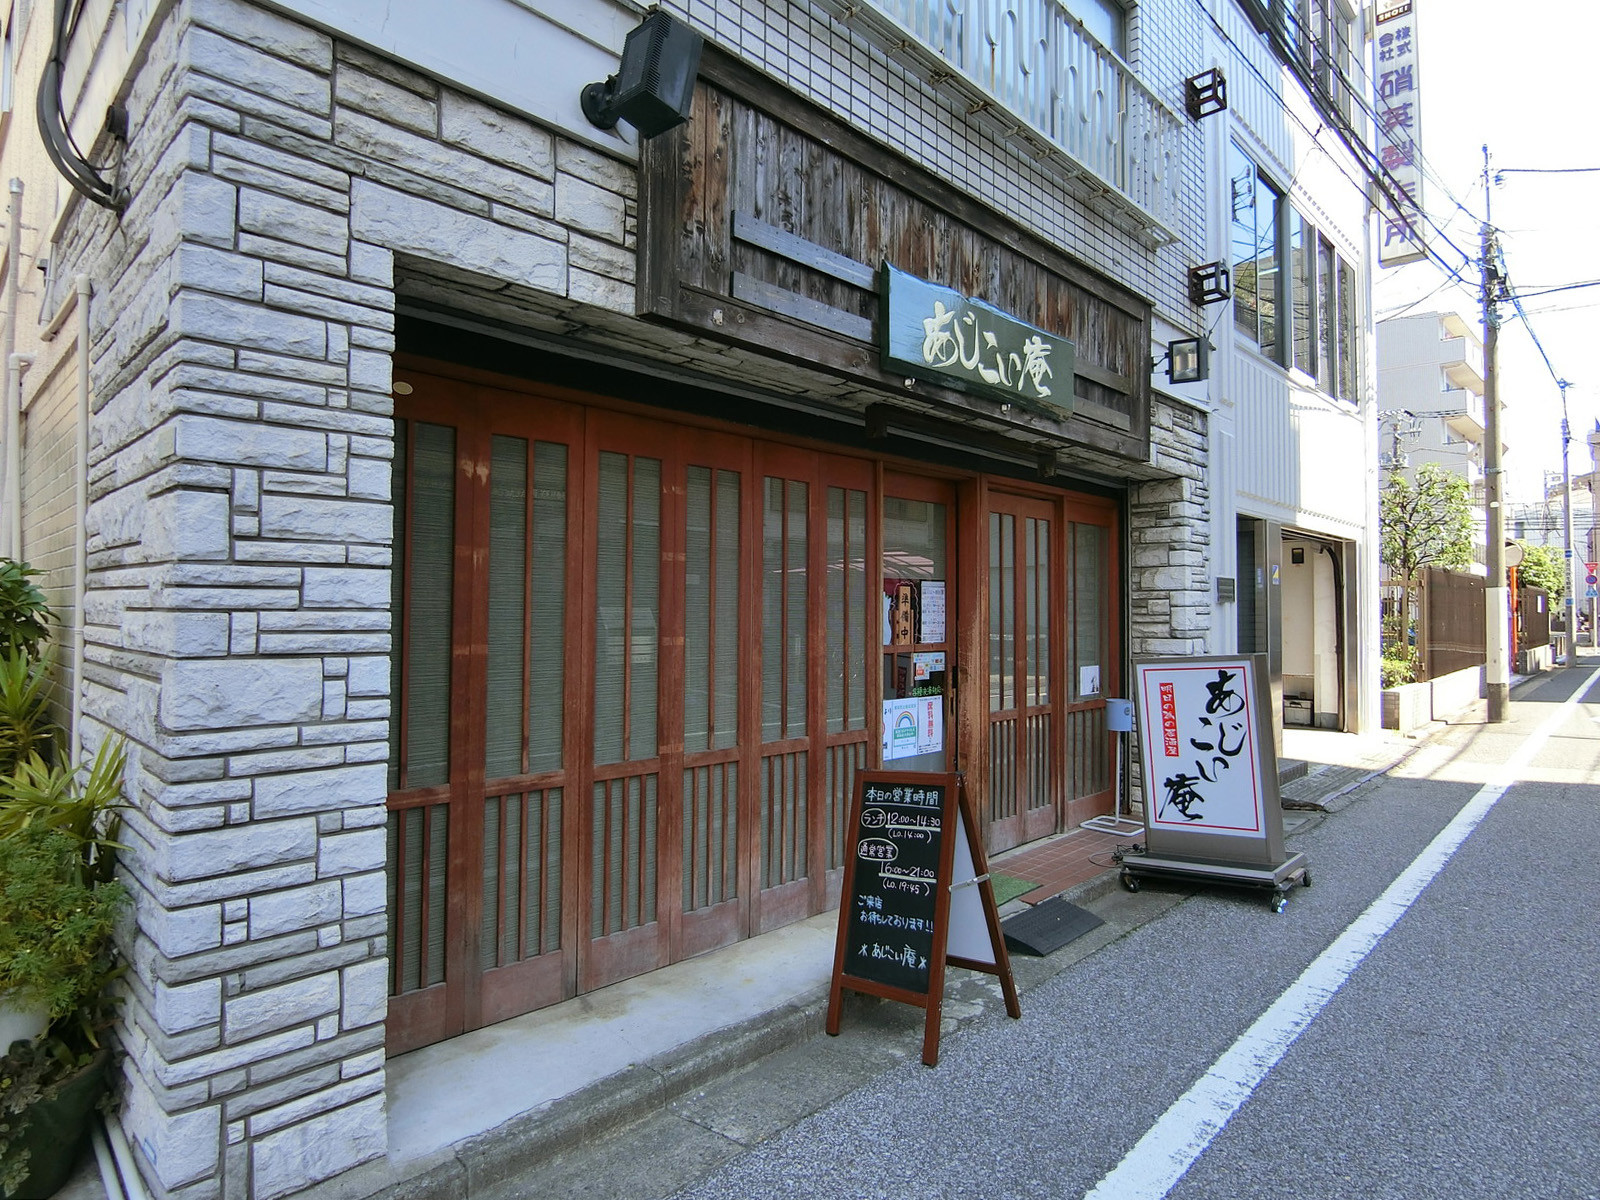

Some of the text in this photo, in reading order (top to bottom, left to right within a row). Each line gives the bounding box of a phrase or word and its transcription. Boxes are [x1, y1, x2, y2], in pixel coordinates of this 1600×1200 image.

[922, 300, 1053, 398] あじこい庵
[865, 786, 939, 806] 本日の営業時間
[863, 812, 884, 826] ランチ
[857, 894, 884, 910] ご来店
